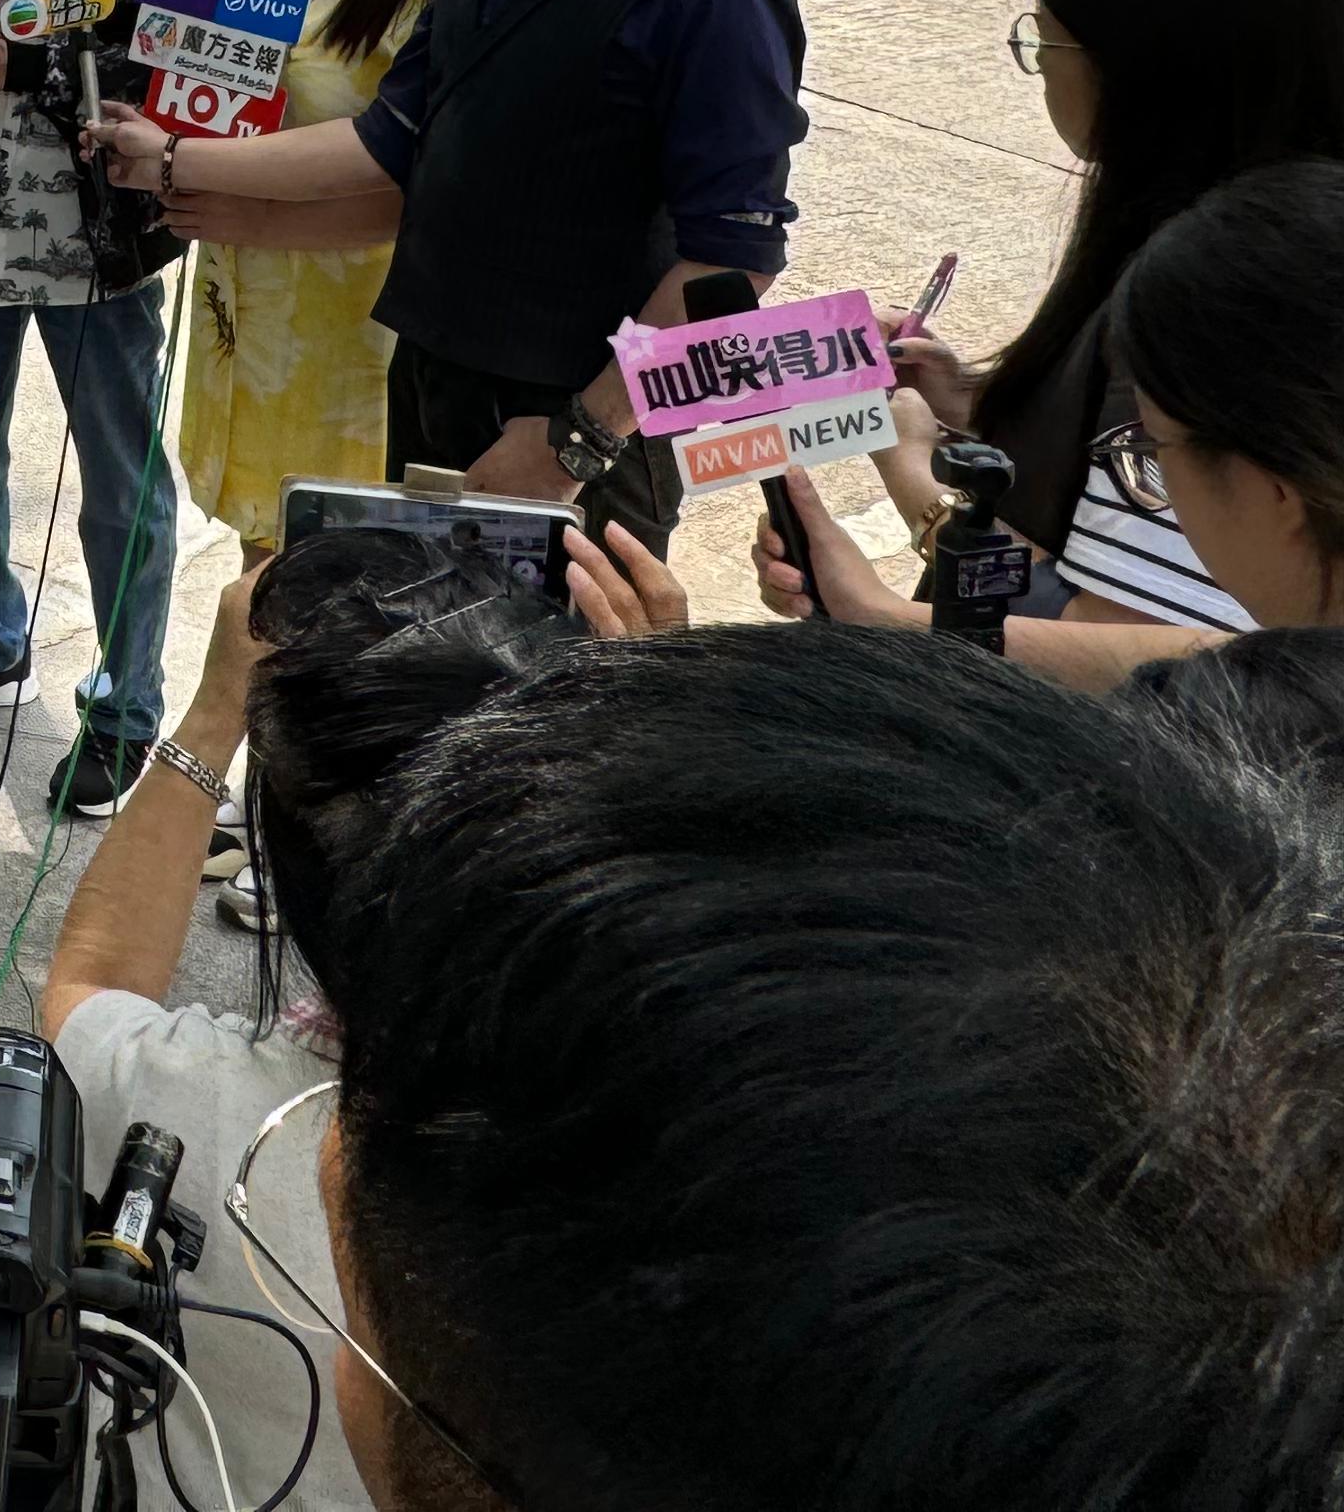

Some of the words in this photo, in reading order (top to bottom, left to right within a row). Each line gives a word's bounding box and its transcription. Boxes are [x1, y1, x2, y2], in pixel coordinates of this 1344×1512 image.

[156, 71, 251, 135] HOY
[696, 435, 779, 475] MVM
[789, 406, 884, 452] NEWS
